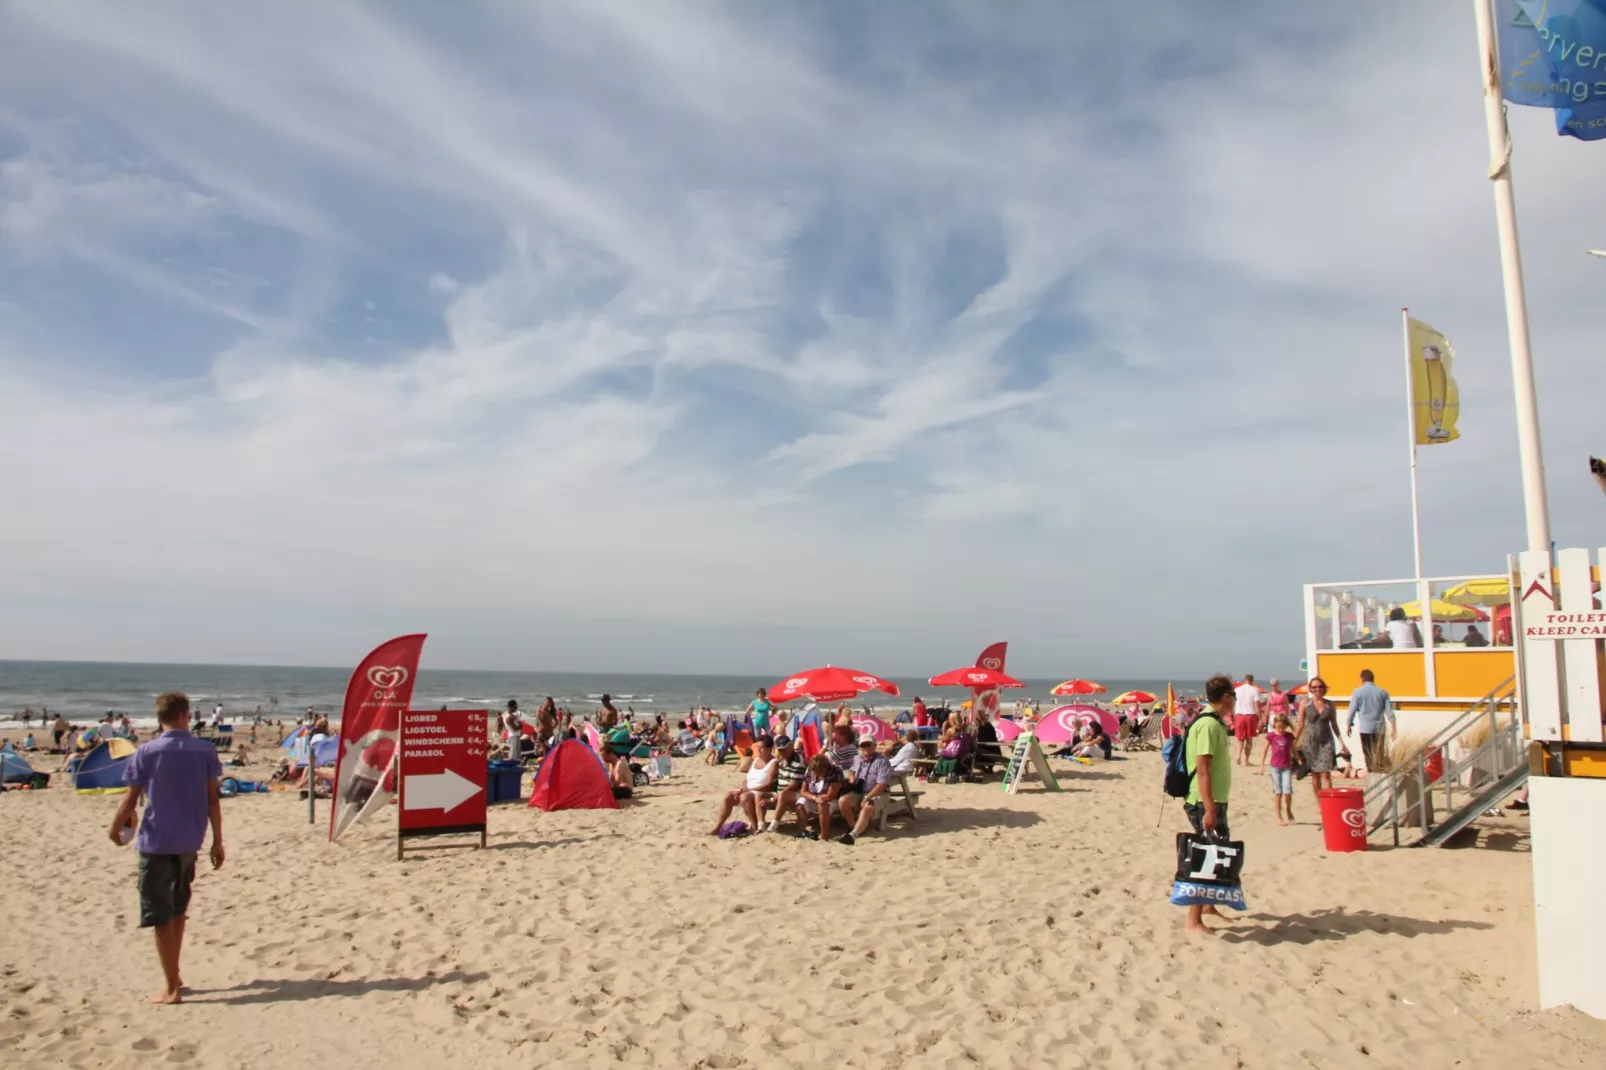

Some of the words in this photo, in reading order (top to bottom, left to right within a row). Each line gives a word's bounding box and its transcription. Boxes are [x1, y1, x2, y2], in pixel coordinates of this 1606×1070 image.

[1547, 614, 1606, 623] TOILET
[1526, 627, 1576, 636] KLEED
[373, 690, 397, 700] OLA
[405, 714, 438, 723] LIGBED
[405, 726, 448, 734] LIGSTOEL
[404, 737, 464, 746] WINDSCHERM
[404, 749, 445, 758] PARASOL
[1189, 841, 1237, 880] F
